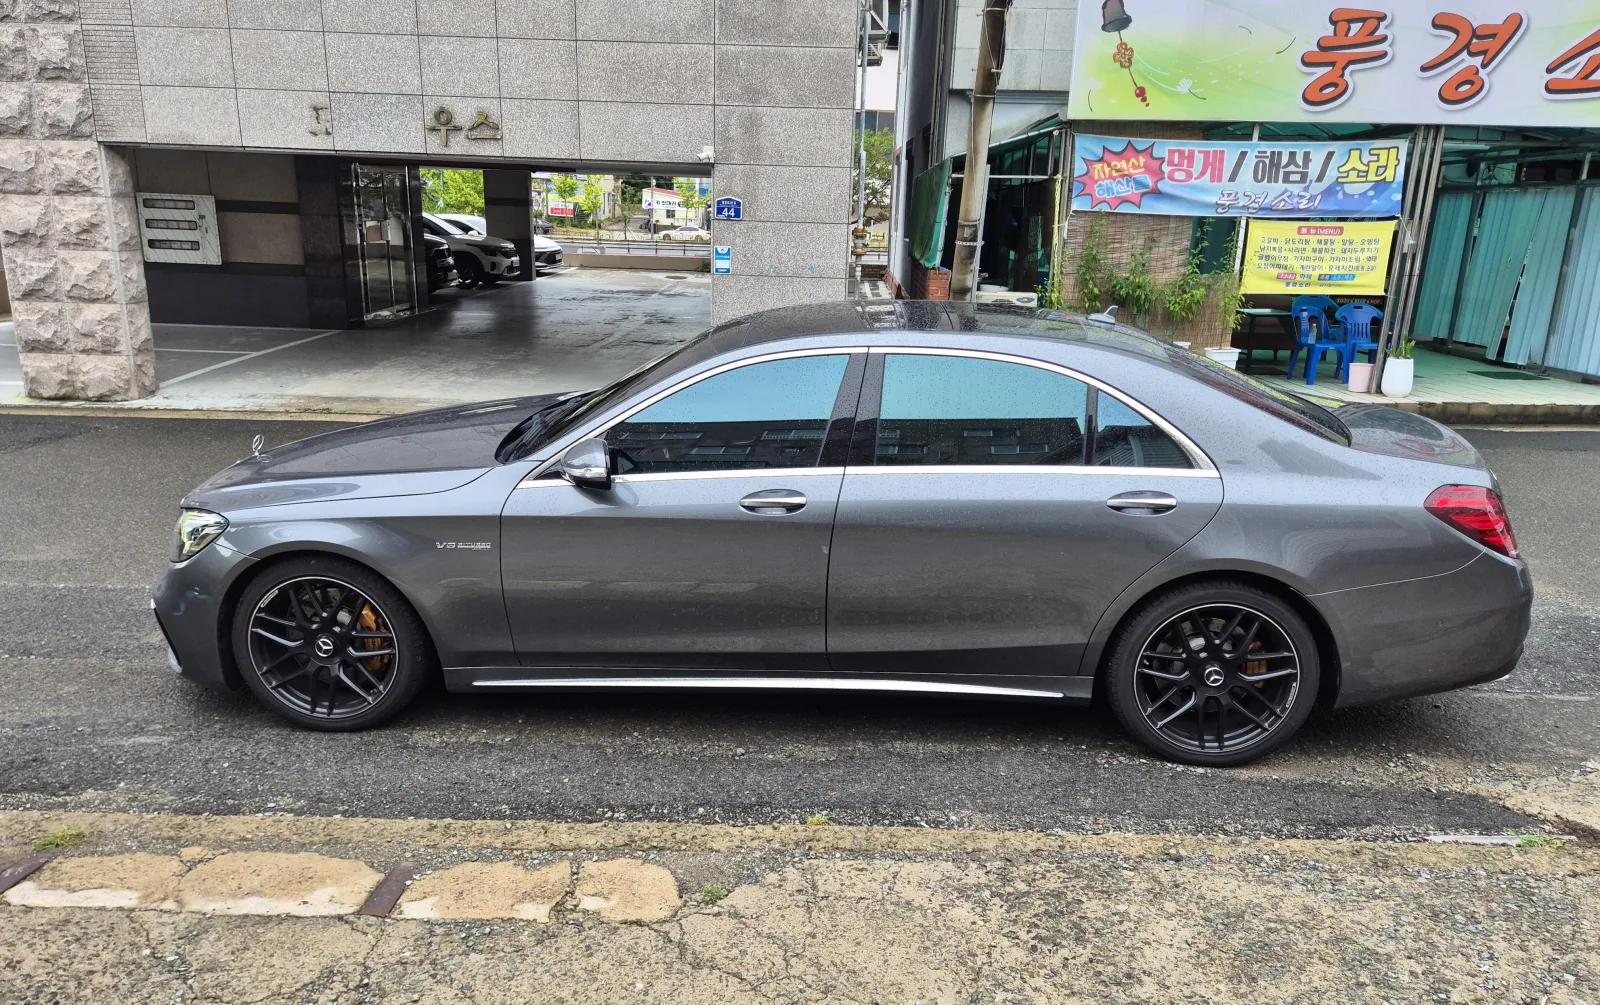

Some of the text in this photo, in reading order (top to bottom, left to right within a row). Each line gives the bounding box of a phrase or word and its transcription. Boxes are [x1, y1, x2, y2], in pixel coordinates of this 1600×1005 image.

[1091, 155, 1147, 180] 자연산
[1095, 175, 1151, 199] 해산물
[722, 207, 735, 217] 44
[1316, 238, 1335, 246] 해물탕
